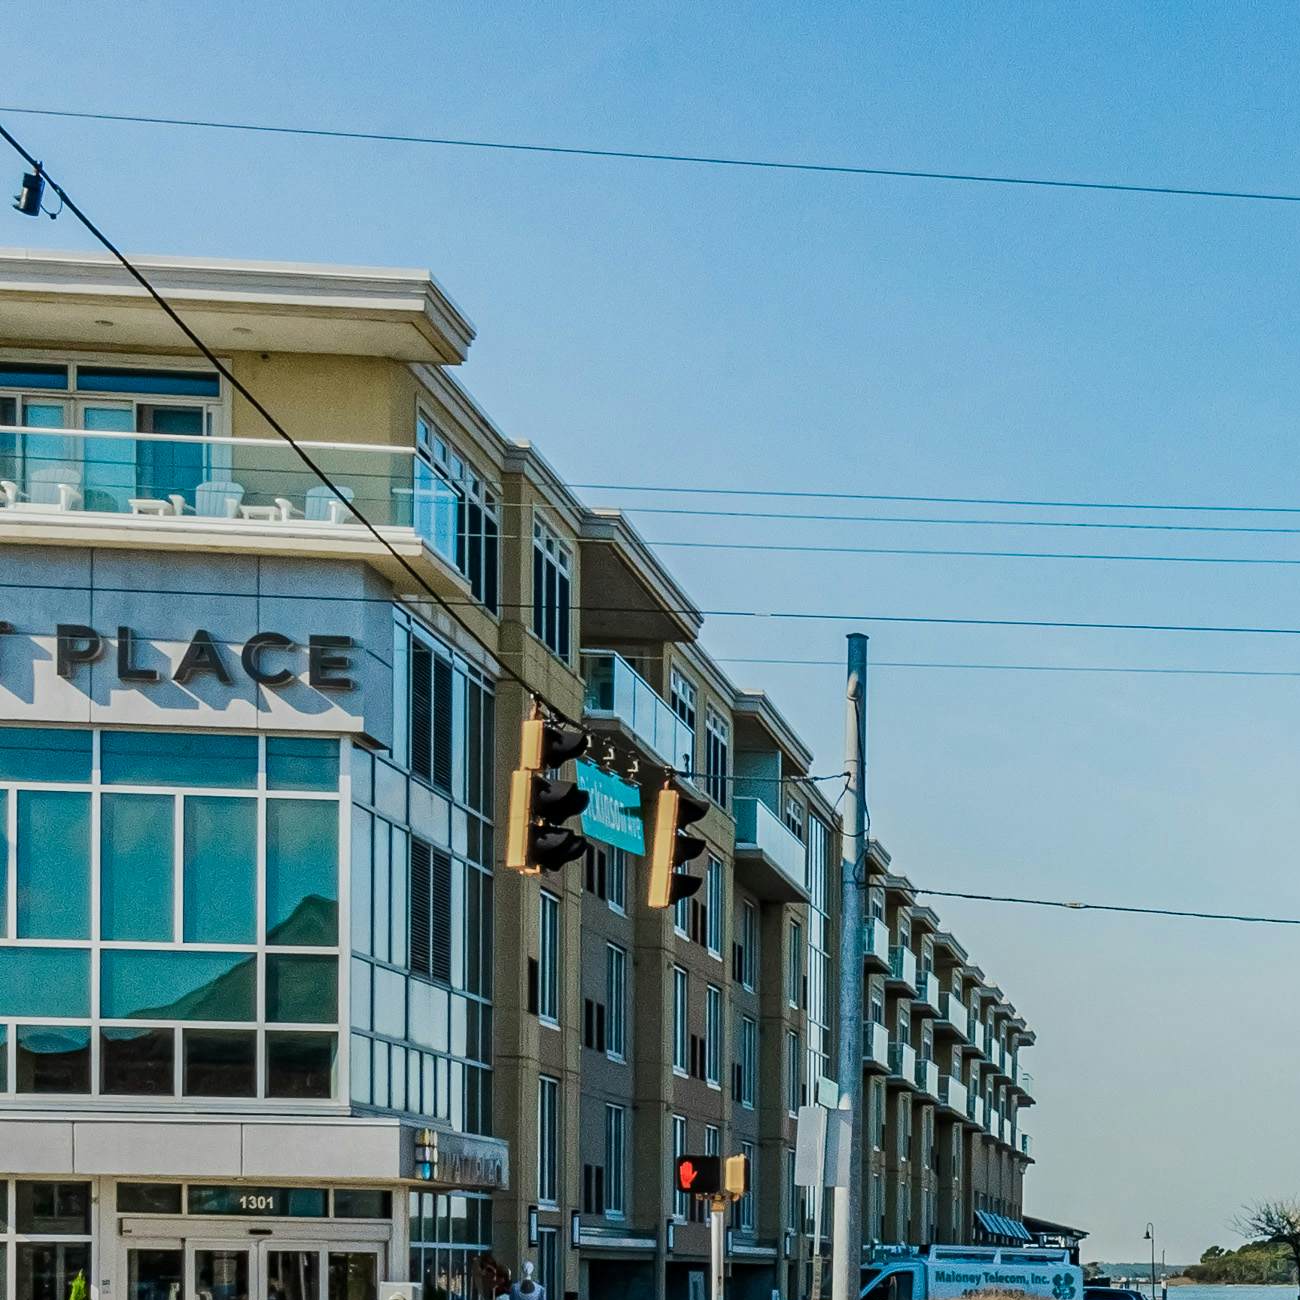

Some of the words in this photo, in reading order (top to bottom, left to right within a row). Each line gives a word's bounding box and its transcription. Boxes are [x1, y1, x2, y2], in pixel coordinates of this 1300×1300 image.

[57, 624, 354, 690] PLACE
[240, 1195, 274, 1209] 1301
[935, 1271, 981, 1285] Maloney
[982, 1271, 1029, 1285] Telecom,
[1031, 1273, 1050, 1285] Inc.
